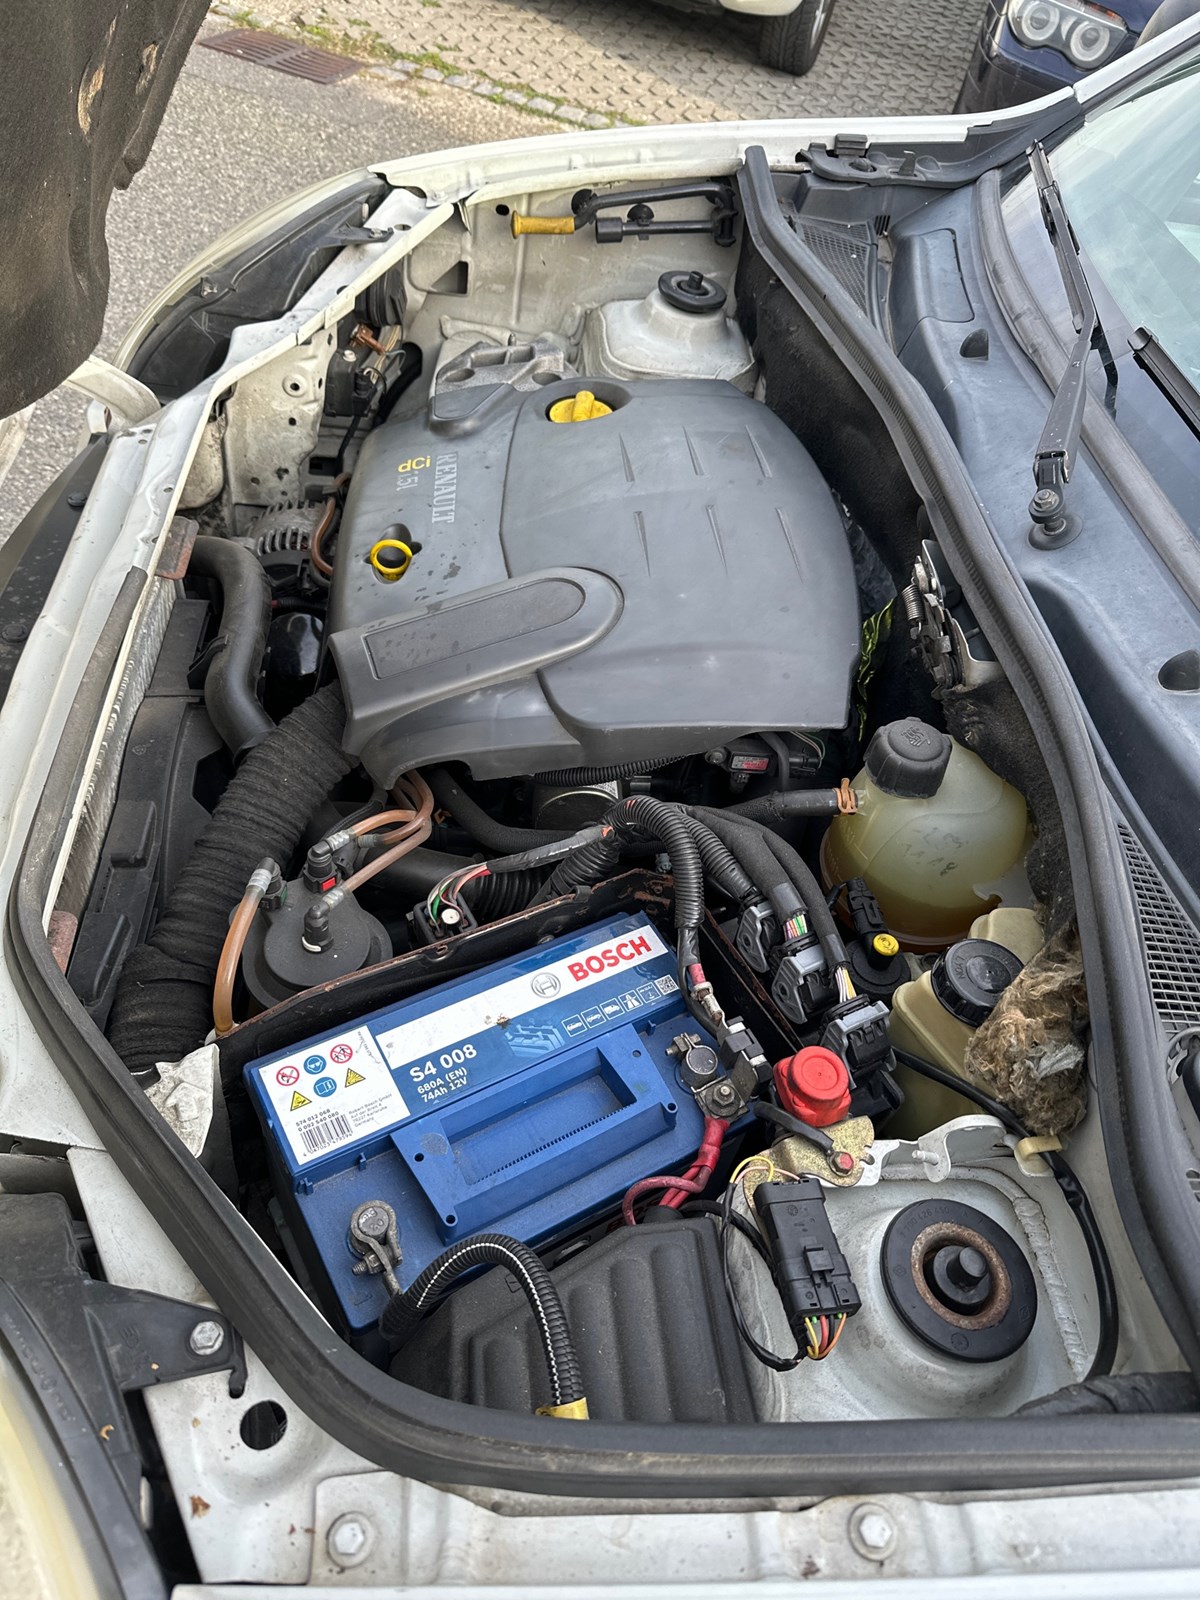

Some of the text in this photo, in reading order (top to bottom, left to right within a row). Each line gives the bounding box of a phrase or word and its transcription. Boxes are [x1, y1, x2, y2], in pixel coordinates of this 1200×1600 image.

[398, 455, 431, 473] dCi
[432, 453, 457, 523] RENAULT
[568, 936, 651, 982] BOSCH
[409, 1043, 478, 1083] S4 008
[417, 1066, 468, 1095] 680A (EN)
[421, 1077, 468, 1103] 74Ah 12V
[307, 1113, 319, 1121] 012
[319, 1108, 331, 1116] 068
[328, 1111, 339, 1119] 080
